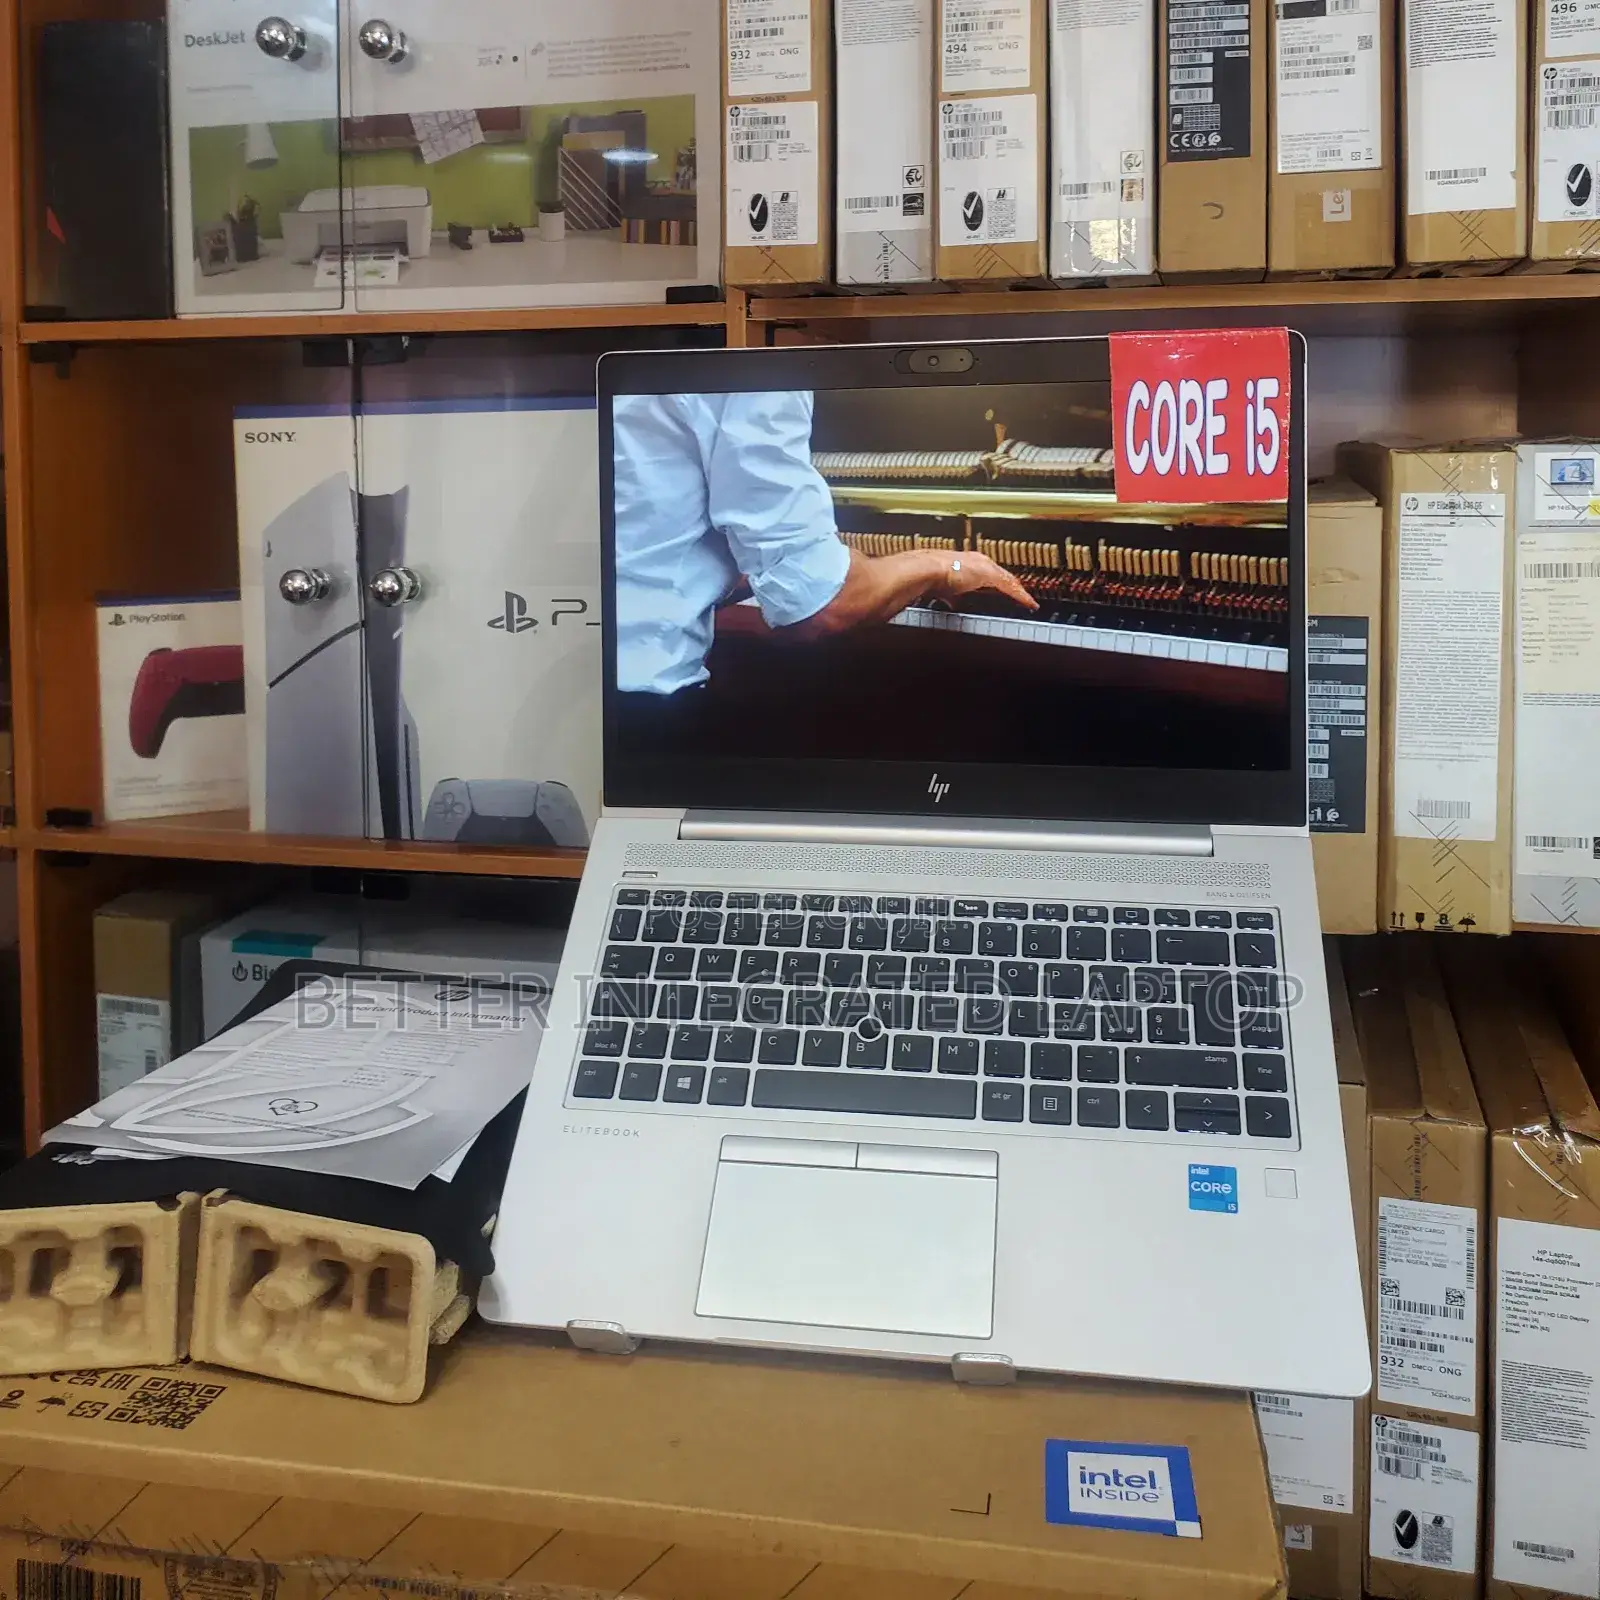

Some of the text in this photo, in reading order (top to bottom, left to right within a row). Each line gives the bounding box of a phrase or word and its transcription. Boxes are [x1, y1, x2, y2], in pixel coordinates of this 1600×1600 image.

[1551, 2, 1577, 14] 496
[184, 30, 246, 48] DeskJet
[731, 50, 751, 60] 932
[780, 48, 799, 56] ONG
[945, 43, 967, 54] 494
[998, 41, 1019, 49] ONG
[1330, 190, 1344, 214] Le
[1125, 377, 1280, 476] CORE i5
[244, 431, 296, 443] SONY
[130, 613, 186, 624] PlayStation
[689, 928, 698, 936] 2
[730, 929, 739, 938] 3
[772, 932, 780, 940] 4
[814, 933, 821, 941] 5
[856, 935, 864, 943] 6
[899, 936, 906, 944] 7
[942, 938, 950, 947] 8
[986, 940, 994, 949] 9
[665, 953, 675, 962] Q
[707, 955, 720, 964] W
[747, 956, 756, 965] E
[789, 958, 798, 967] R
[832, 960, 840, 969] T
[876, 961, 885, 971] Y
[919, 964, 928, 973] U
[1007, 968, 1018, 977] O
[1052, 970, 1061, 980] P
[668, 992, 677, 1000] A
[710, 993, 718, 1003] S
[752, 995, 761, 1004] D
[839, 999, 849, 1008] G
[882, 1000, 892, 1010] H
[972, 1005, 981, 1015] K
[1017, 1008, 1026, 1018] L
[400, 1006, 449, 1016] Product
[451, 1011, 527, 1023] Information
[681, 1032, 959, 1055] Z X C V B N M
[1204, 1055, 1228, 1063] stamp
[563, 1124, 640, 1137] ELITEBOOK
[1190, 1167, 1210, 1176] intel
[1227, 1203, 1237, 1212] i5
[1387, 1222, 1446, 1235] CONFIDENCE CARGO
[1549, 1250, 1573, 1260] Laptop
[1380, 1355, 1404, 1368] 932
[1438, 1366, 1462, 1377] ONG
[1079, 1466, 1158, 1490] intel
